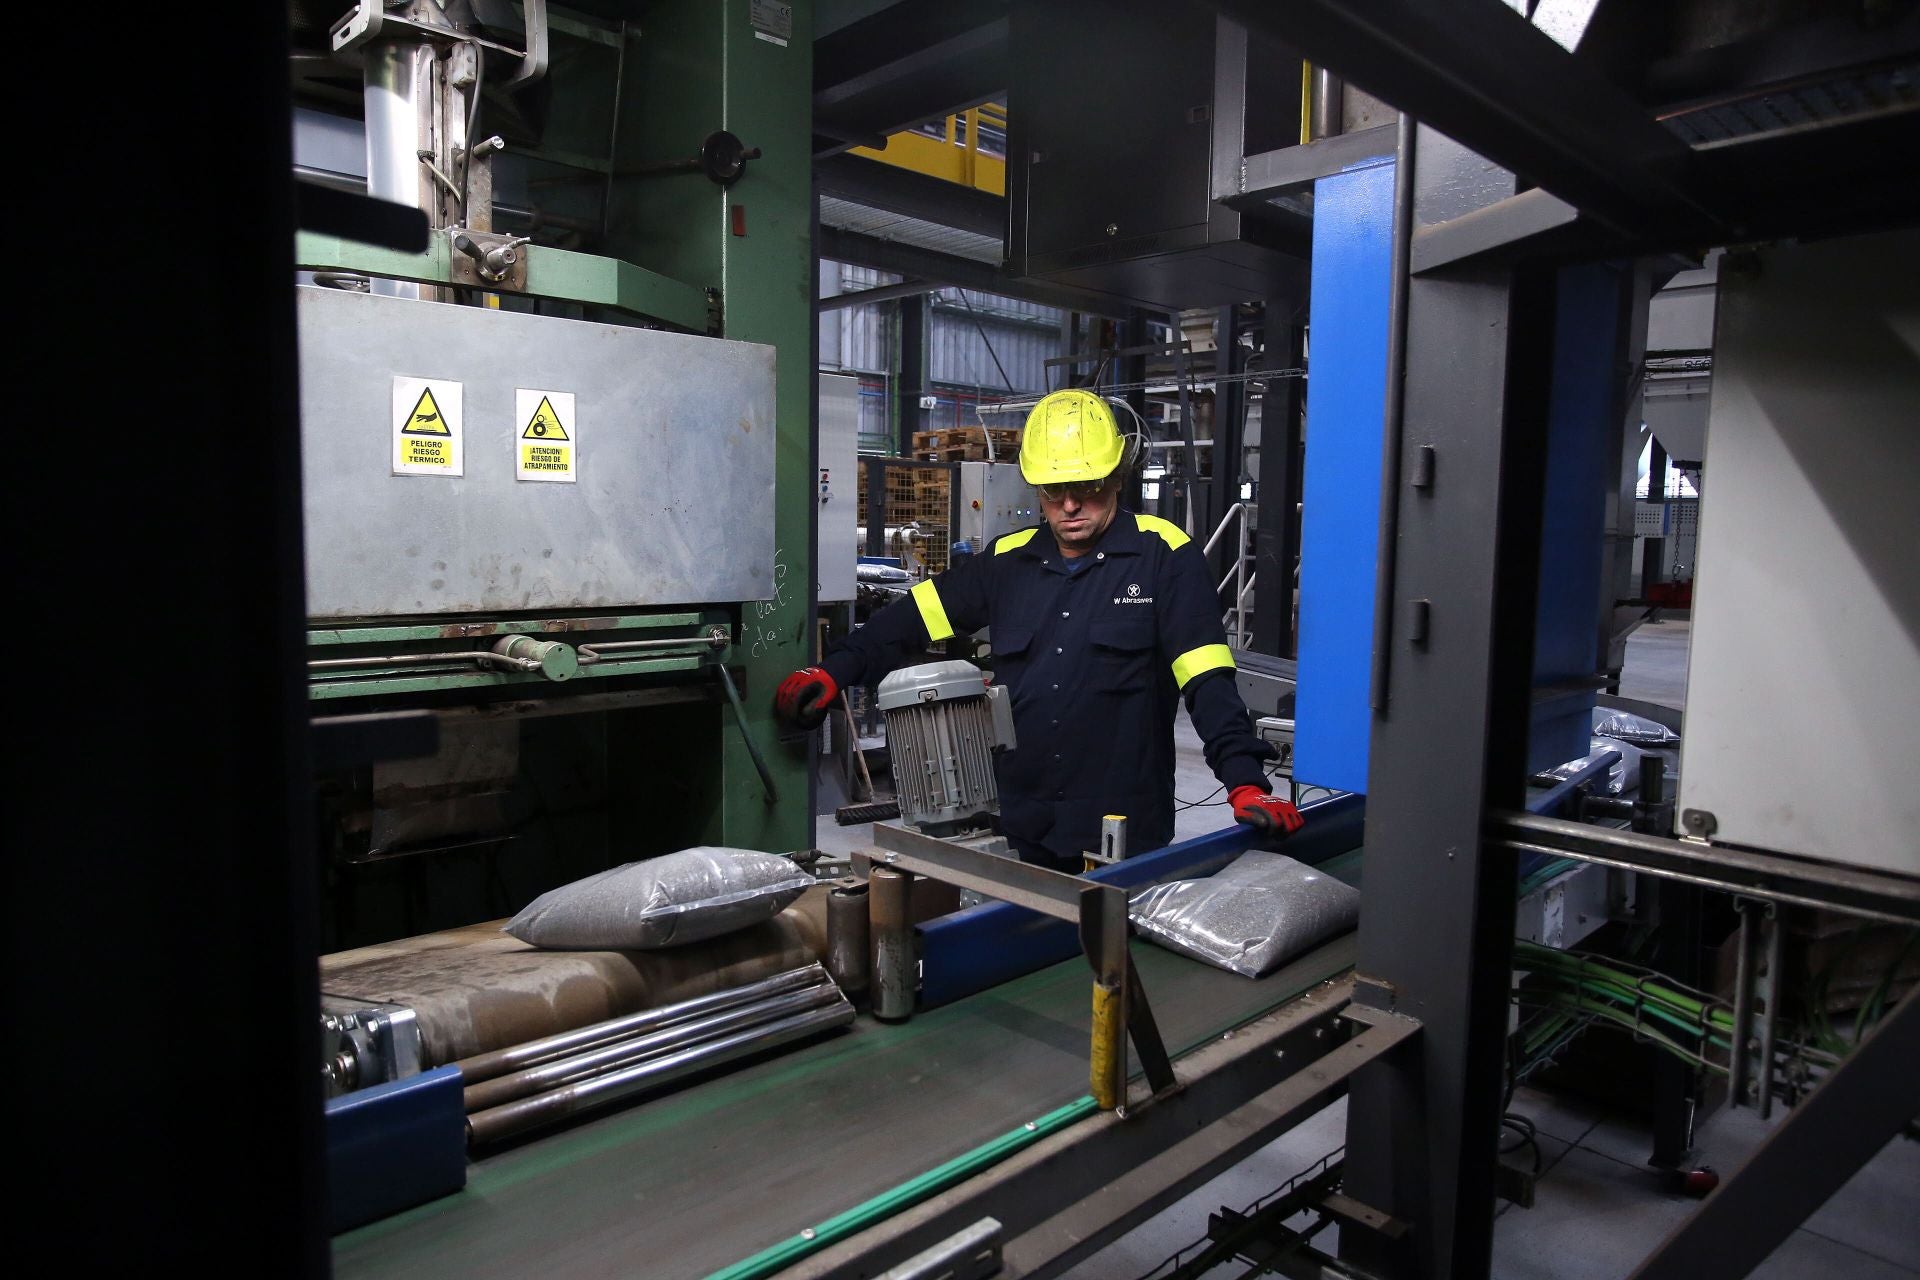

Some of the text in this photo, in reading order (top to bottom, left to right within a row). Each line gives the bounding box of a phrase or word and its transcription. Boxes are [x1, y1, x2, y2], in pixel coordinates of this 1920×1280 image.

[410, 440, 443, 448] PELIGRO
[413, 448, 441, 456] RIESGO
[408, 456, 445, 464] TERMICO
[553, 455, 561, 463] DE
[524, 462, 568, 471] ATRAPAMIENTO
[1113, 597, 1121, 605] W
